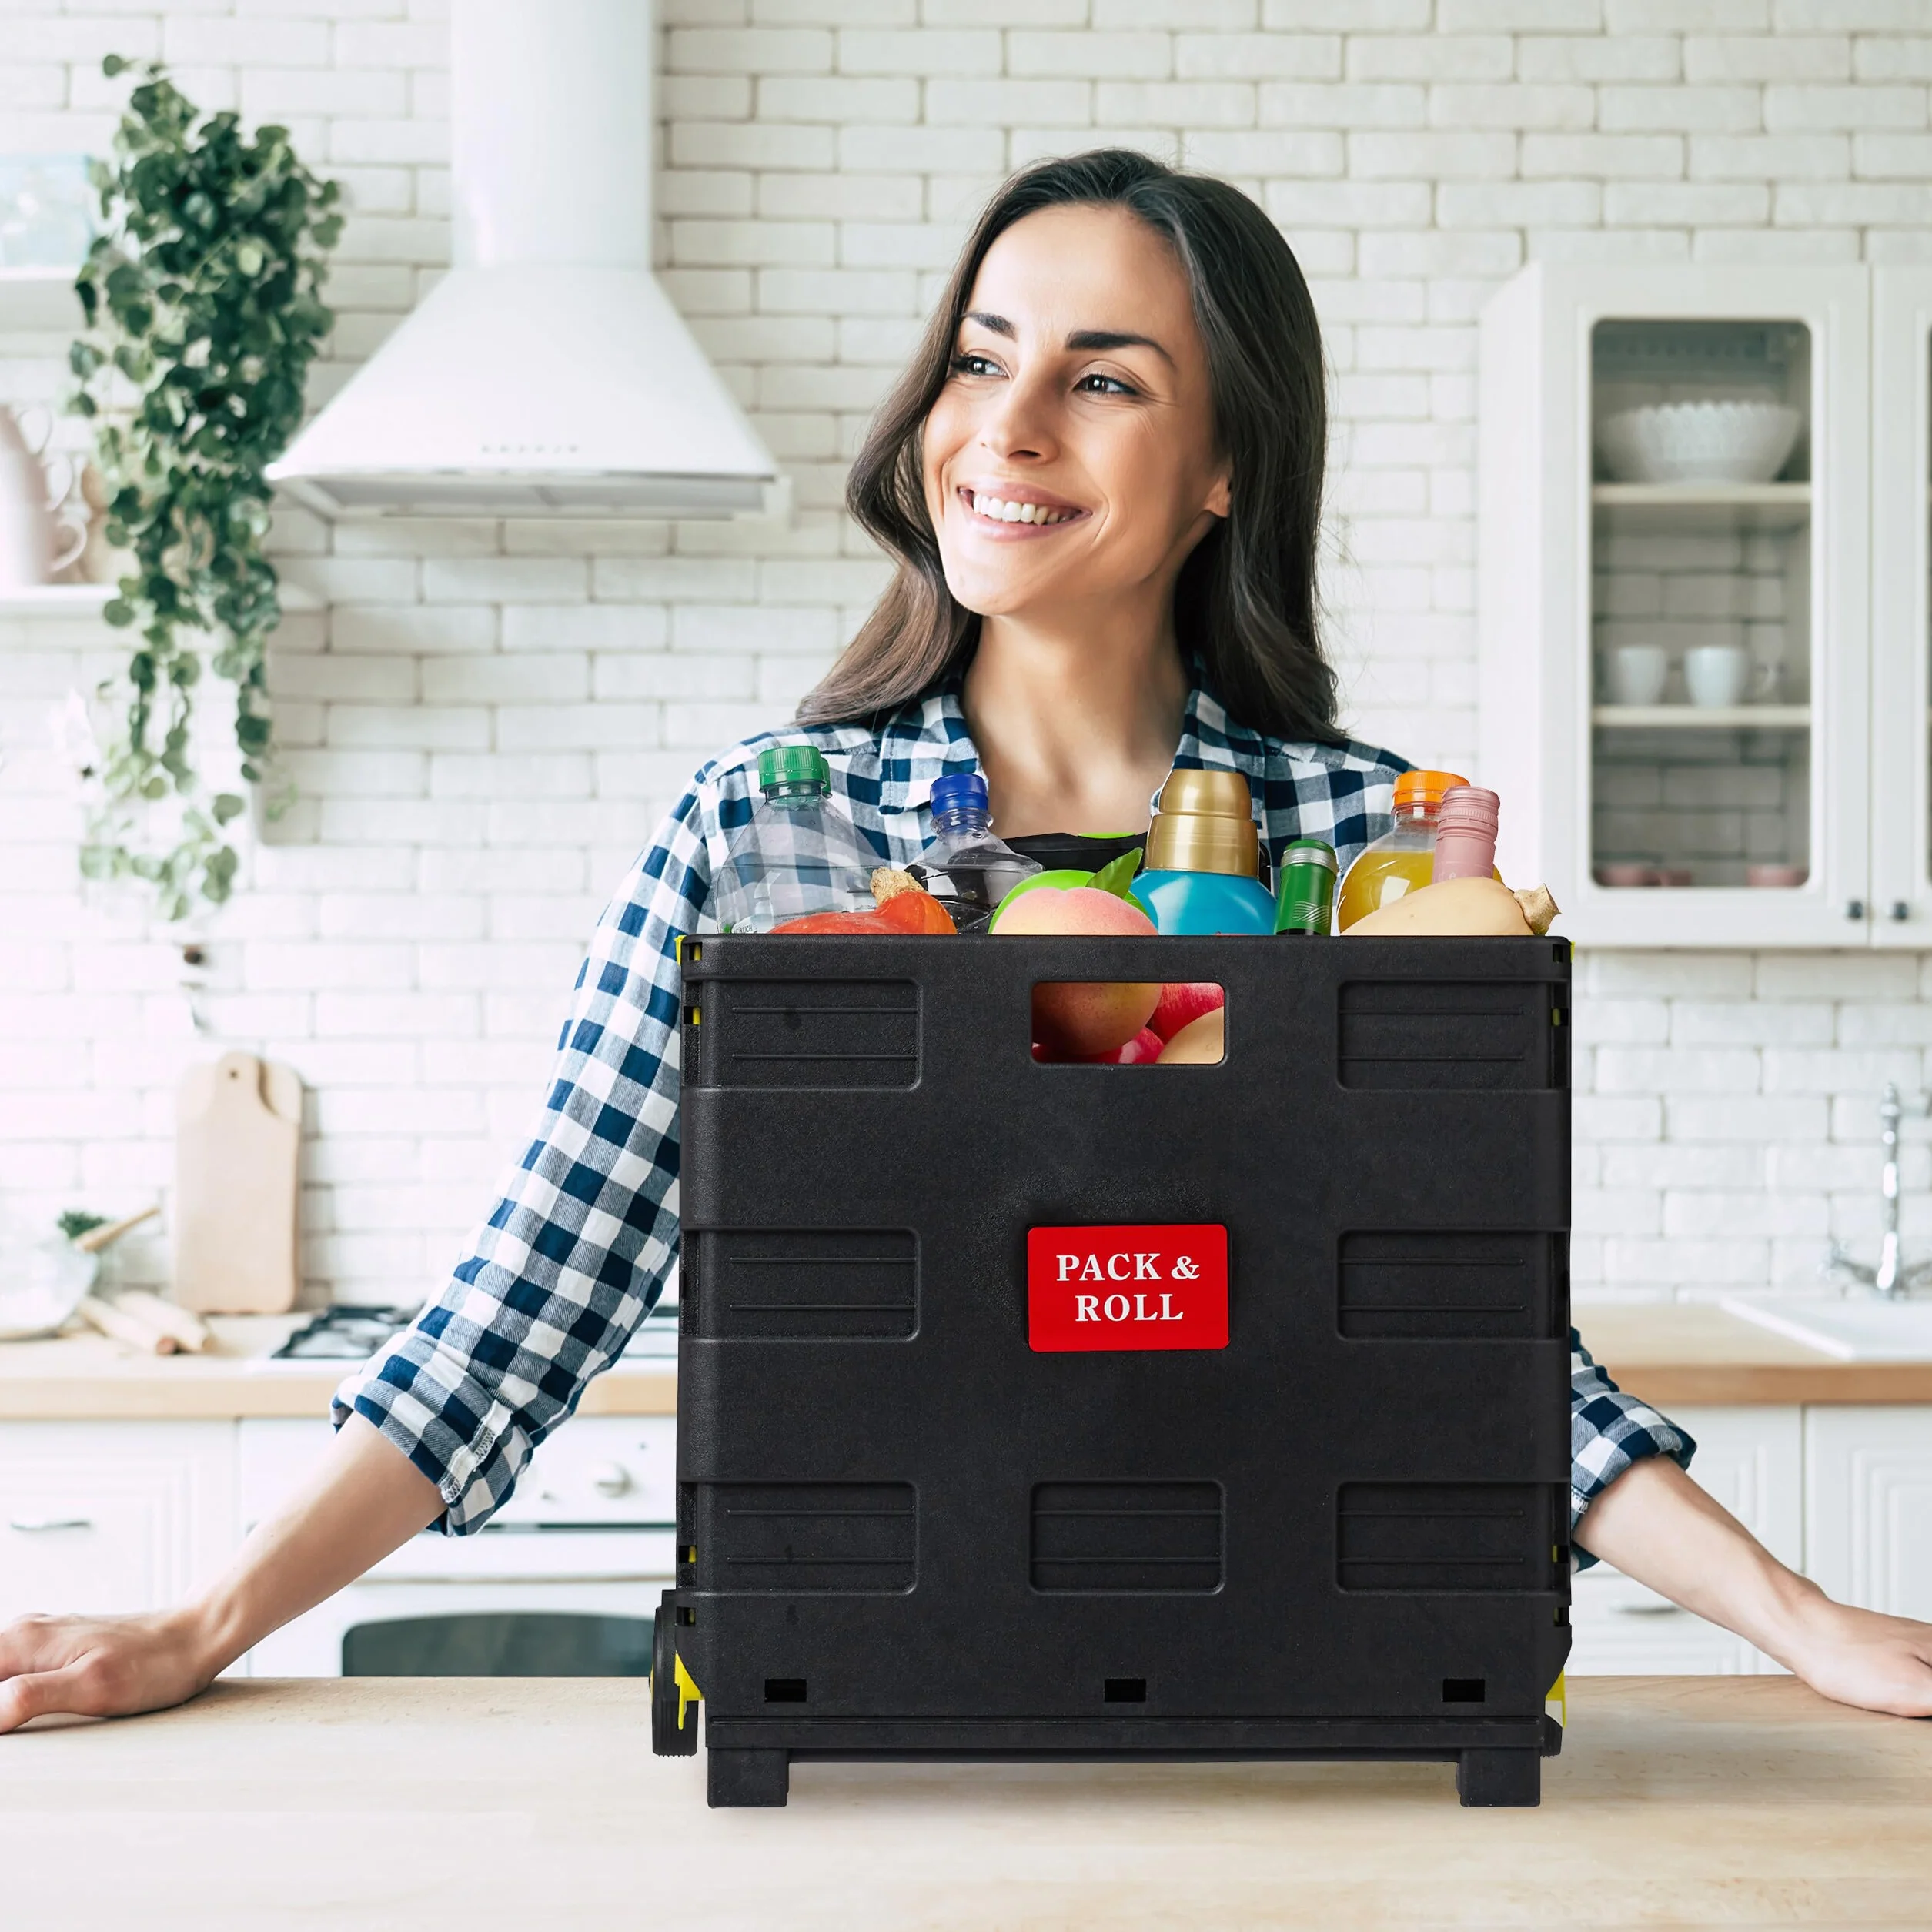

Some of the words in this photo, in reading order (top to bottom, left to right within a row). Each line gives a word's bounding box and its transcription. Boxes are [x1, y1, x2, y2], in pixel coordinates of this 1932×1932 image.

[1056, 1253, 1162, 1281] PACK
[1171, 1255, 1200, 1280] &
[1075, 1294, 1184, 1322] ROLL
